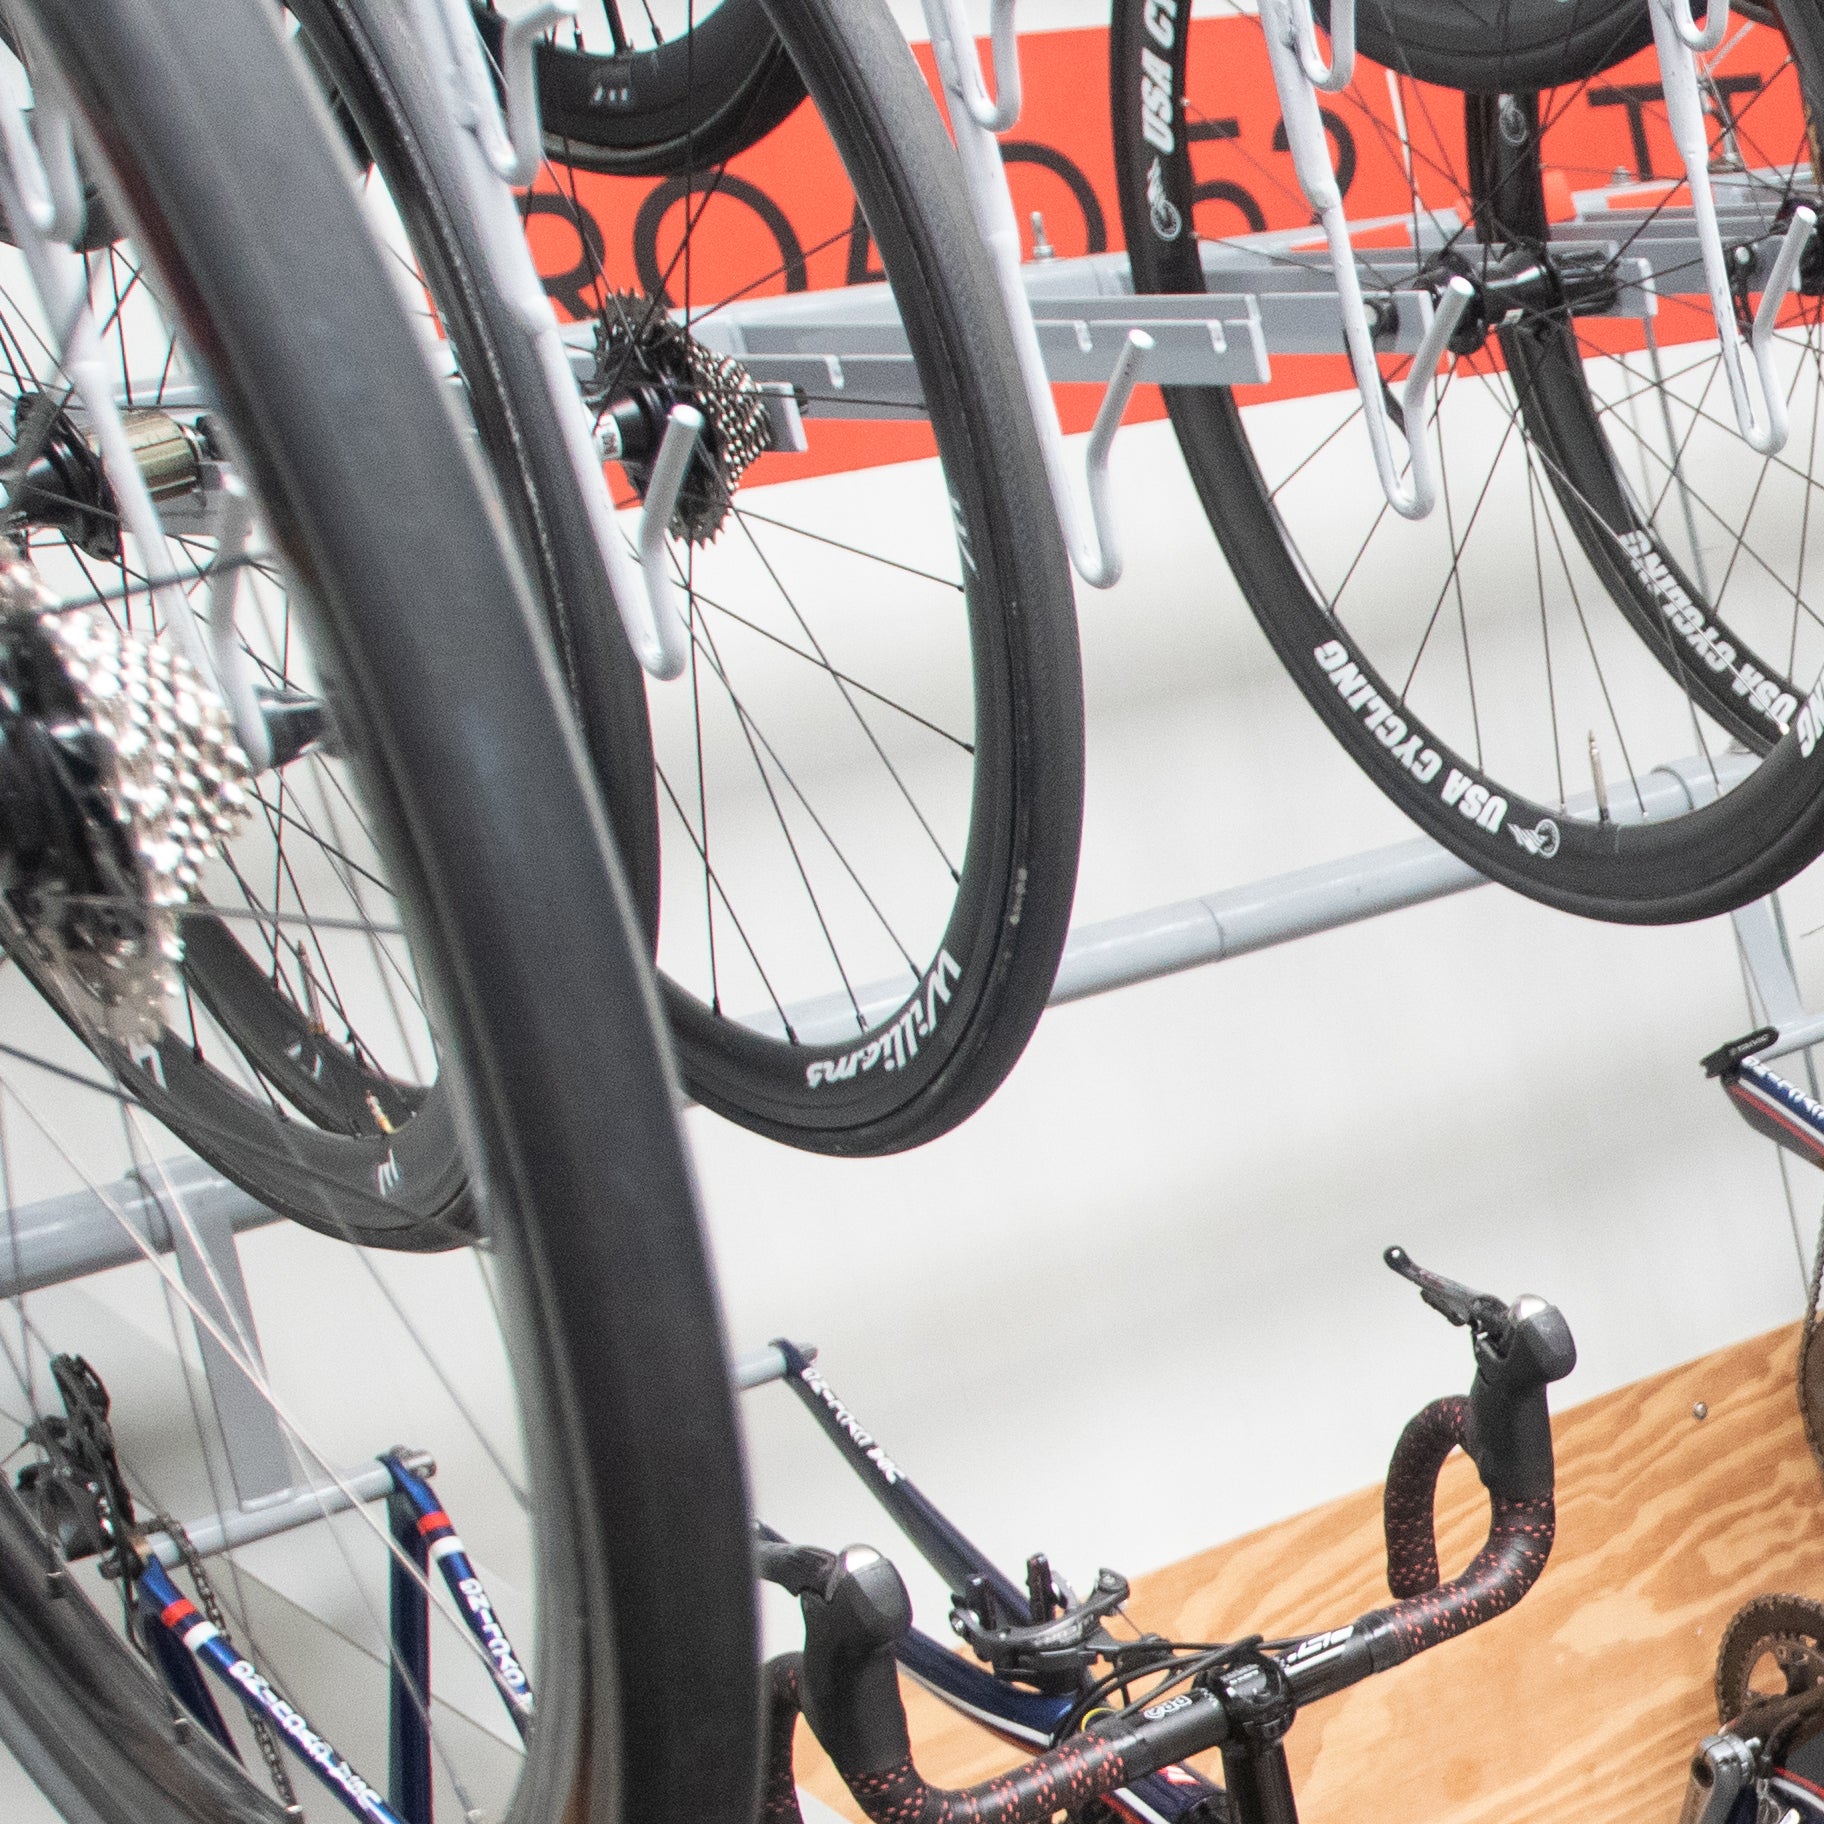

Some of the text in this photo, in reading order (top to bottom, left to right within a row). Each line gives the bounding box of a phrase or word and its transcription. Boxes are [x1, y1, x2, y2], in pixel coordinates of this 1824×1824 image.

[1141, 46, 1175, 155] USA
[1618, 530, 1799, 729] USA CYCLING
[1314, 639, 1509, 832] USA CYCLING
[806, 949, 962, 1089] Williams
[800, 1365, 907, 1485] USA CYCLING
[229, 1656, 336, 1765] CYCLING
